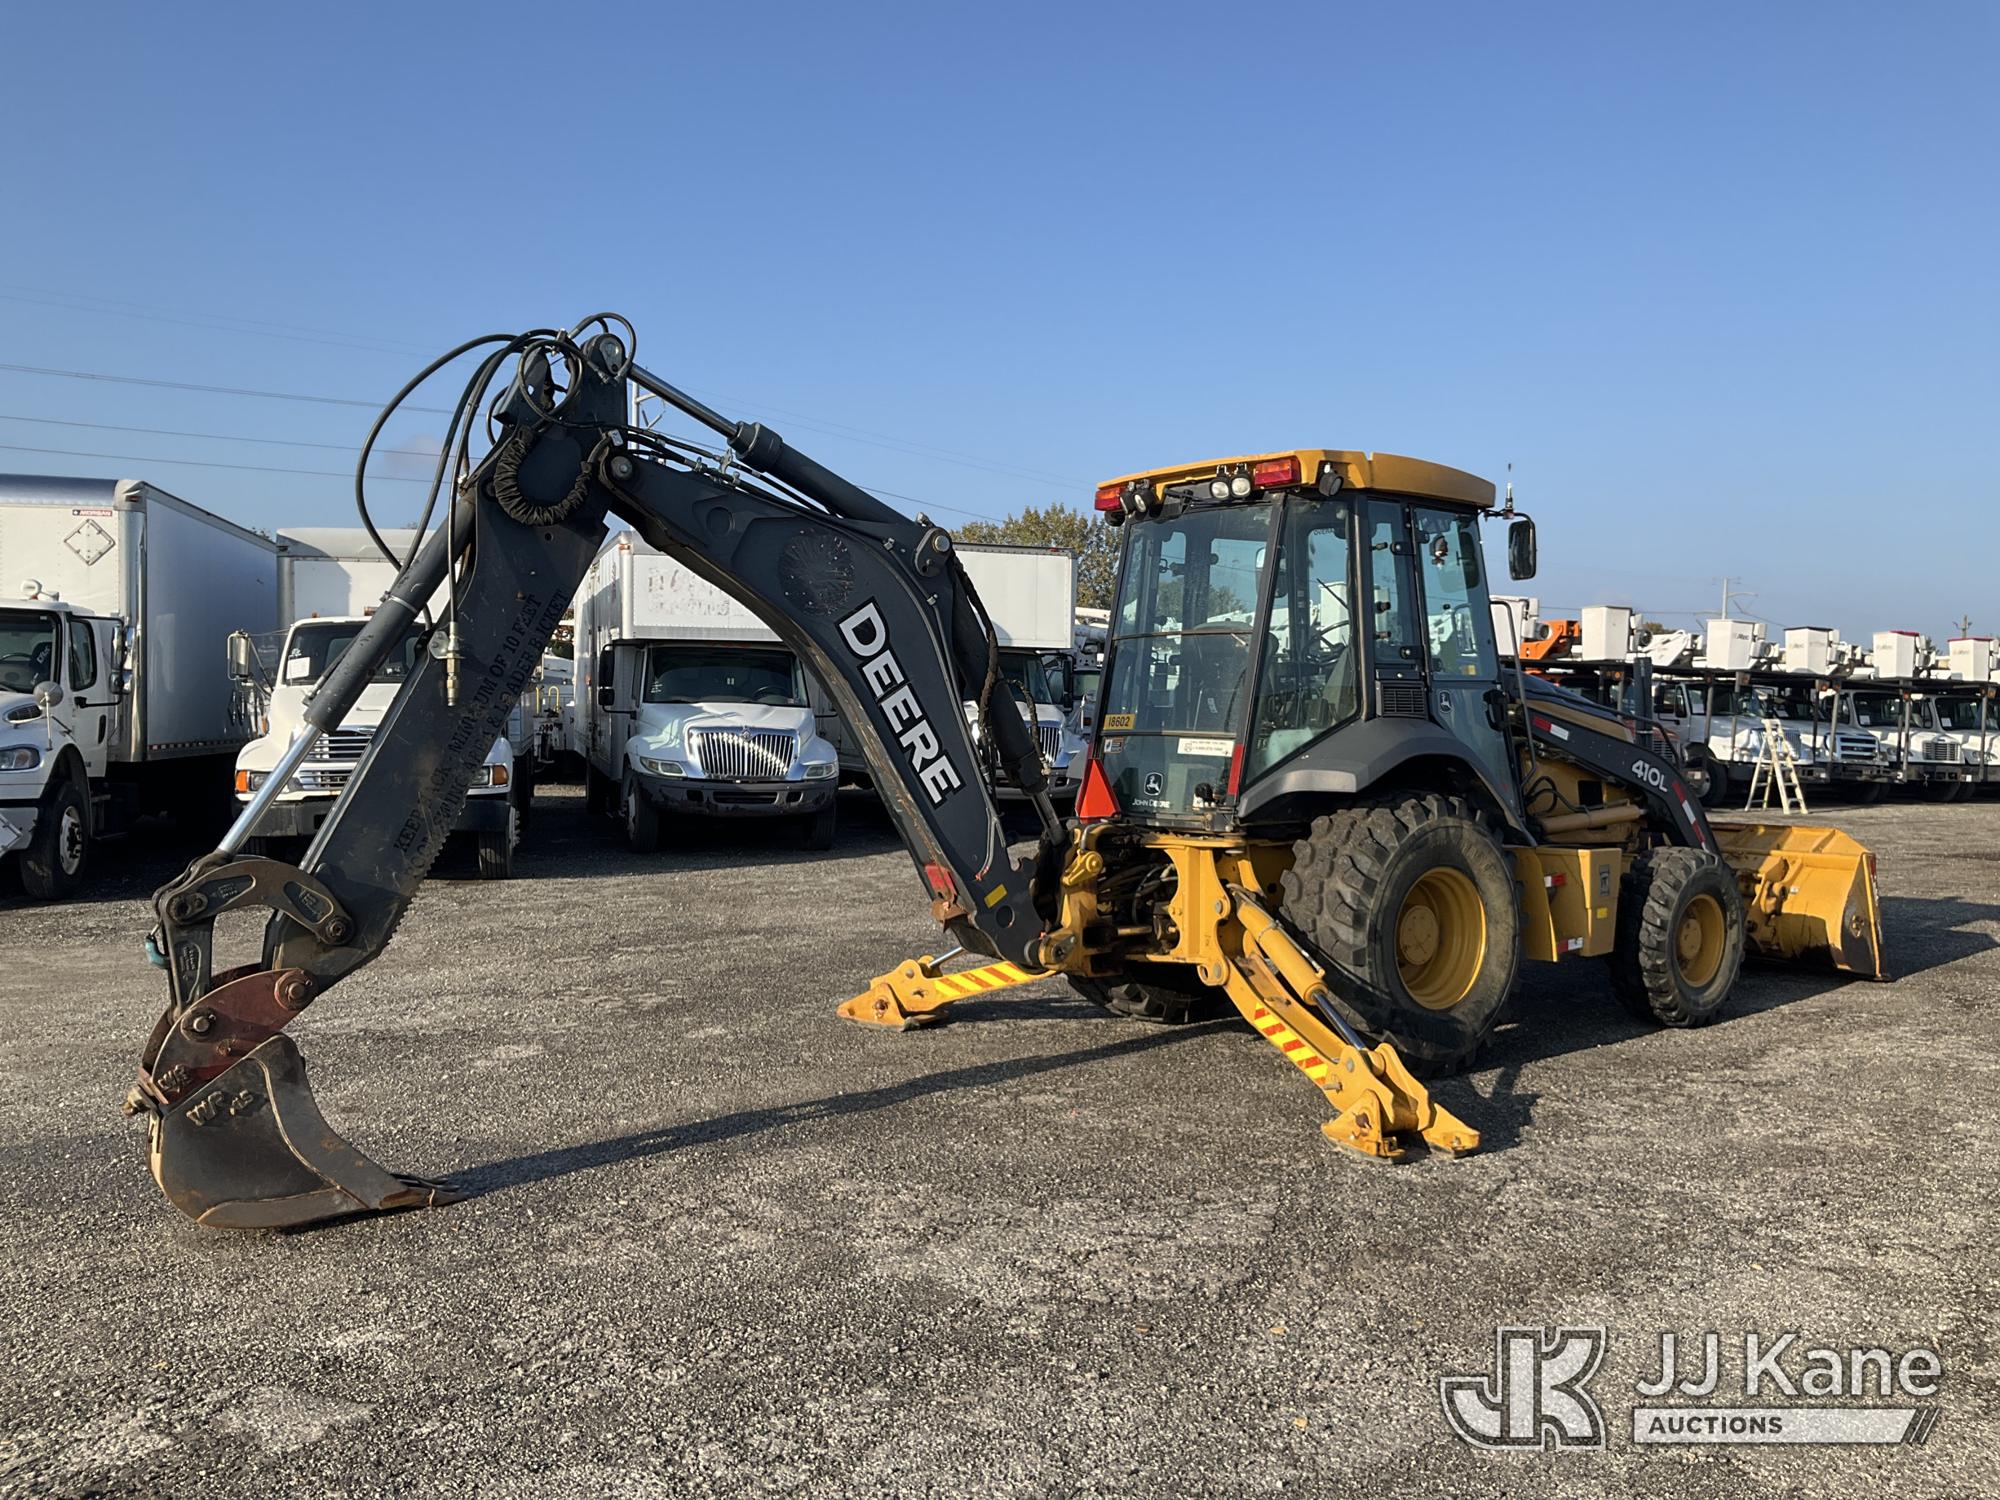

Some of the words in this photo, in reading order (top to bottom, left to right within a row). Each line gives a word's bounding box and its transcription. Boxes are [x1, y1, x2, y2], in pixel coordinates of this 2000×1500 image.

[839, 602, 961, 804] DEERE
[392, 808, 426, 850] KEEP
[418, 767, 451, 808] ACK
[446, 677, 498, 753] MINIUM
[488, 653, 508, 677] OF
[502, 634, 520, 653] 10
[511, 593, 542, 635] FEET
[485, 715, 502, 728] &
[1108, 716, 1131, 727] 18602
[1631, 759, 1668, 793] 410L
